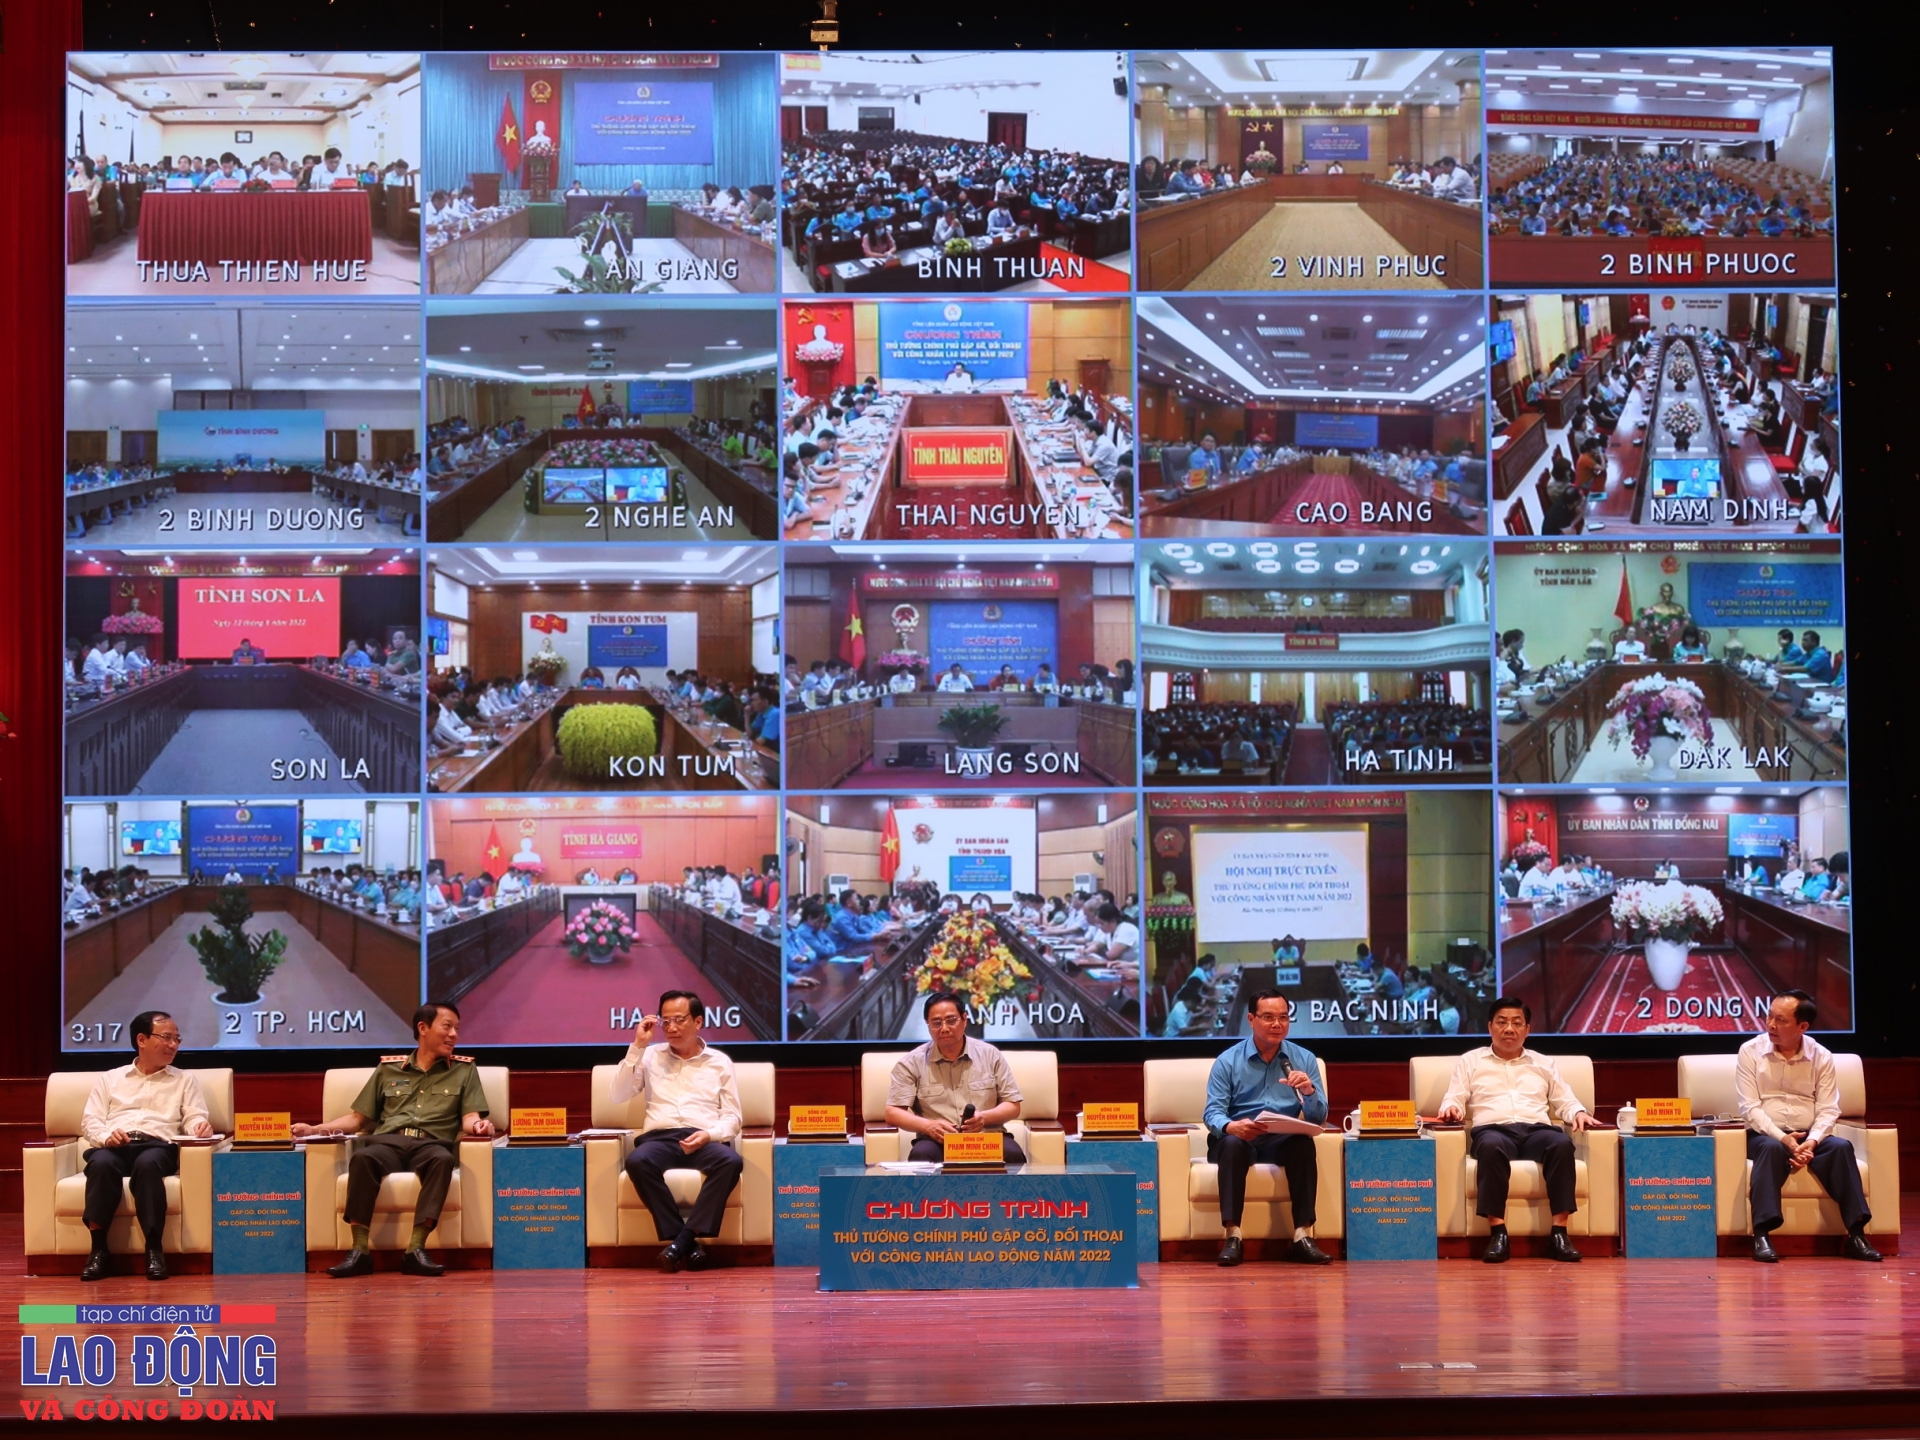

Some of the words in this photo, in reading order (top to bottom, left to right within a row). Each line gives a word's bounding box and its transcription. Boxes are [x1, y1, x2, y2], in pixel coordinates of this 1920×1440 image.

[136, 259, 209, 281] THUA
[219, 259, 300, 281] THIEN
[312, 259, 367, 281] HUE
[605, 258, 643, 280] AN
[657, 258, 739, 280] GIANG
[918, 257, 982, 279] BINH
[994, 257, 1085, 279] THUAN
[1270, 255, 1286, 277] 2
[1297, 255, 1363, 277] VINH
[1376, 254, 1447, 276] PHUC
[1600, 254, 1616, 275] 2
[1629, 253, 1693, 275] BINH
[1706, 252, 1797, 274] PHUOC
[158, 509, 175, 531] 2
[187, 508, 253, 530] BINH
[266, 508, 365, 529] DUONG
[585, 506, 601, 528] 2
[613, 505, 686, 527] NGHE
[697, 505, 735, 527] AN
[896, 504, 960, 526] THAI
[970, 503, 1080, 525] NGUYEN
[1295, 501, 1348, 523] CAO
[1360, 501, 1433, 522] BANG
[1651, 499, 1711, 521] NAM
[1723, 498, 1790, 520] DINH
[195, 586, 245, 603] TỈNH
[251, 588, 291, 603] SƠN
[297, 589, 325, 603] LA
[609, 756, 665, 777] KON
[677, 755, 736, 776] TUM
[945, 753, 1013, 774] LANG
[1024, 752, 1081, 774] SON
[1345, 750, 1380, 771] HA
[1388, 749, 1454, 771] TINH
[1678, 747, 1731, 769] DAK
[1742, 746, 1791, 768] LAK
[271, 759, 328, 780] SON
[340, 758, 371, 779] LA
[964, 1003, 1015, 1025] ANH
[1029, 1003, 1085, 1024] HOA
[1310, 1000, 1359, 1022] BAC
[1372, 999, 1438, 1021] NINH
[1637, 997, 1652, 1018] 2
[1666, 996, 1742, 1018] DONG
[71, 1022, 122, 1042] 3:17
[225, 1012, 242, 1033] 2
[252, 1011, 295, 1032] TP.
[308, 1010, 365, 1031] HCM
[865, 1199, 992, 1220] CHƯƠNG
[999, 1197, 1088, 1219] TRÌNH
[833, 1227, 859, 1244] THỦ
[862, 1227, 910, 1243] TƯỚNG
[913, 1228, 957, 1243] CHÍNH
[960, 1227, 988, 1243] PHỦ
[991, 1229, 1022, 1245] GẶP
[1024, 1228, 1050, 1244] GỠ,
[1053, 1225, 1079, 1242] ĐỐI
[1082, 1229, 1124, 1245] THOẠI
[851, 1248, 875, 1264] VỚI
[878, 1248, 923, 1263] CÔNG
[925, 1248, 965, 1263] NHÂN
[968, 1251, 995, 1263] LAO
[998, 1247, 1040, 1265] ĐỘNG
[1042, 1248, 1076, 1262] NĂM
[1079, 1250, 1111, 1262] 2022
